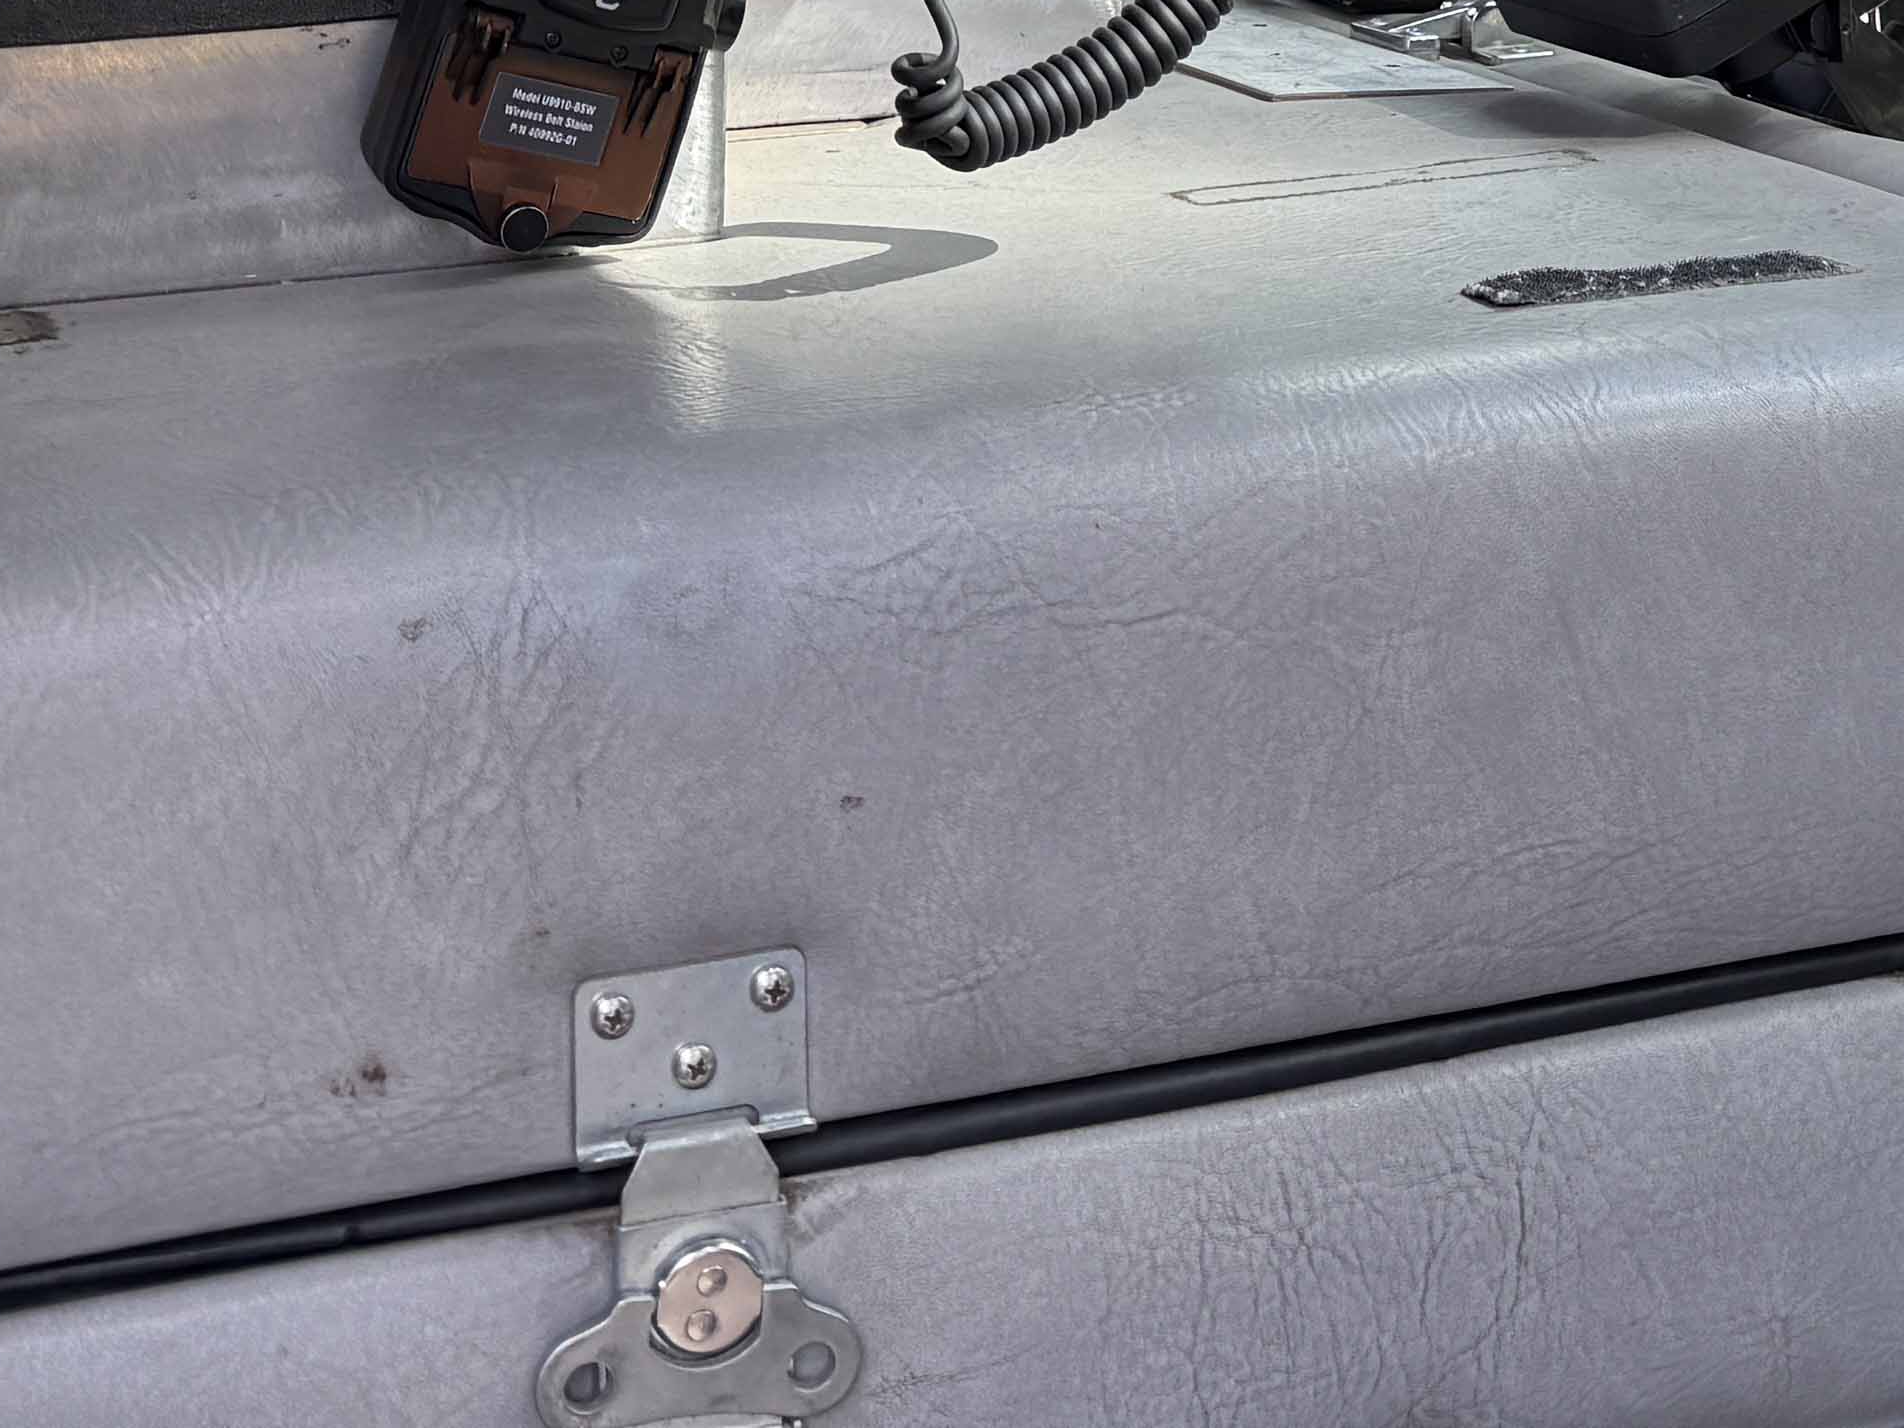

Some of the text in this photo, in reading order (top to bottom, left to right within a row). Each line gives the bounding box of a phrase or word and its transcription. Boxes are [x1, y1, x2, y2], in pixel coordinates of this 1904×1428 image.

[512, 87, 541, 104] Model
[505, 103, 544, 123] Wireless
[545, 112, 564, 126] Belt
[509, 123, 528, 136] P/N
